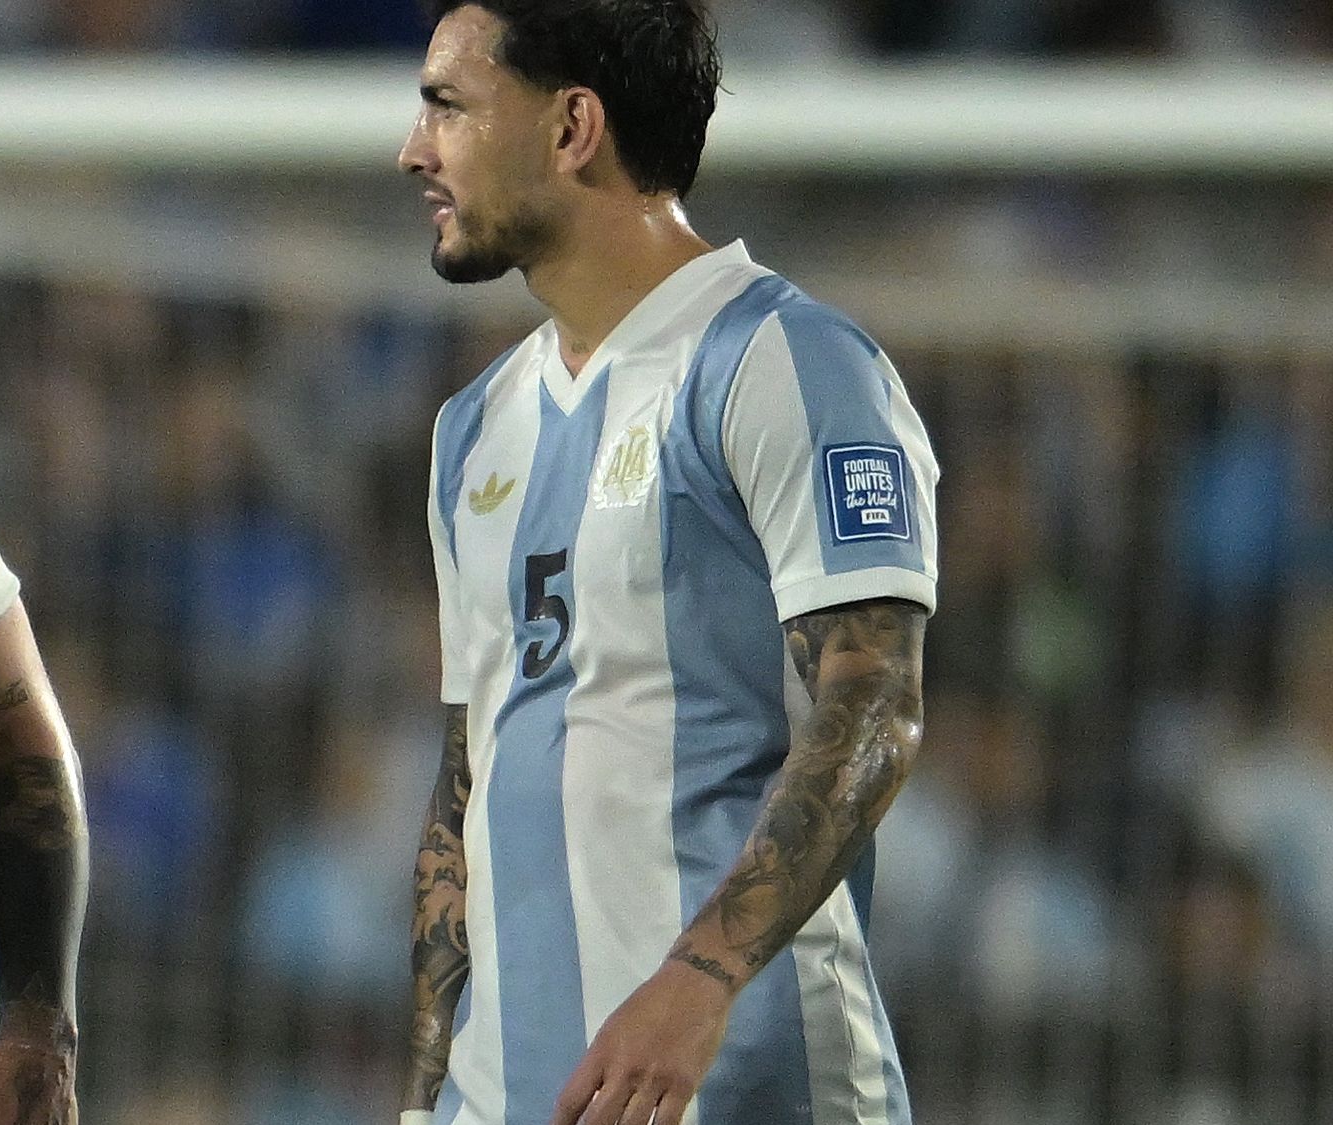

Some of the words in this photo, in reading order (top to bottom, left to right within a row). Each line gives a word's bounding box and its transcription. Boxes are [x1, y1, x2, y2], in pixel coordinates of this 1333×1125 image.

[843, 458, 891, 474] FOOTBALL
[845, 473, 894, 492] UNITES
[843, 493, 866, 509] the
[866, 491, 897, 510] World
[865, 511, 887, 521] FIFA
[522, 548, 570, 680] 5
